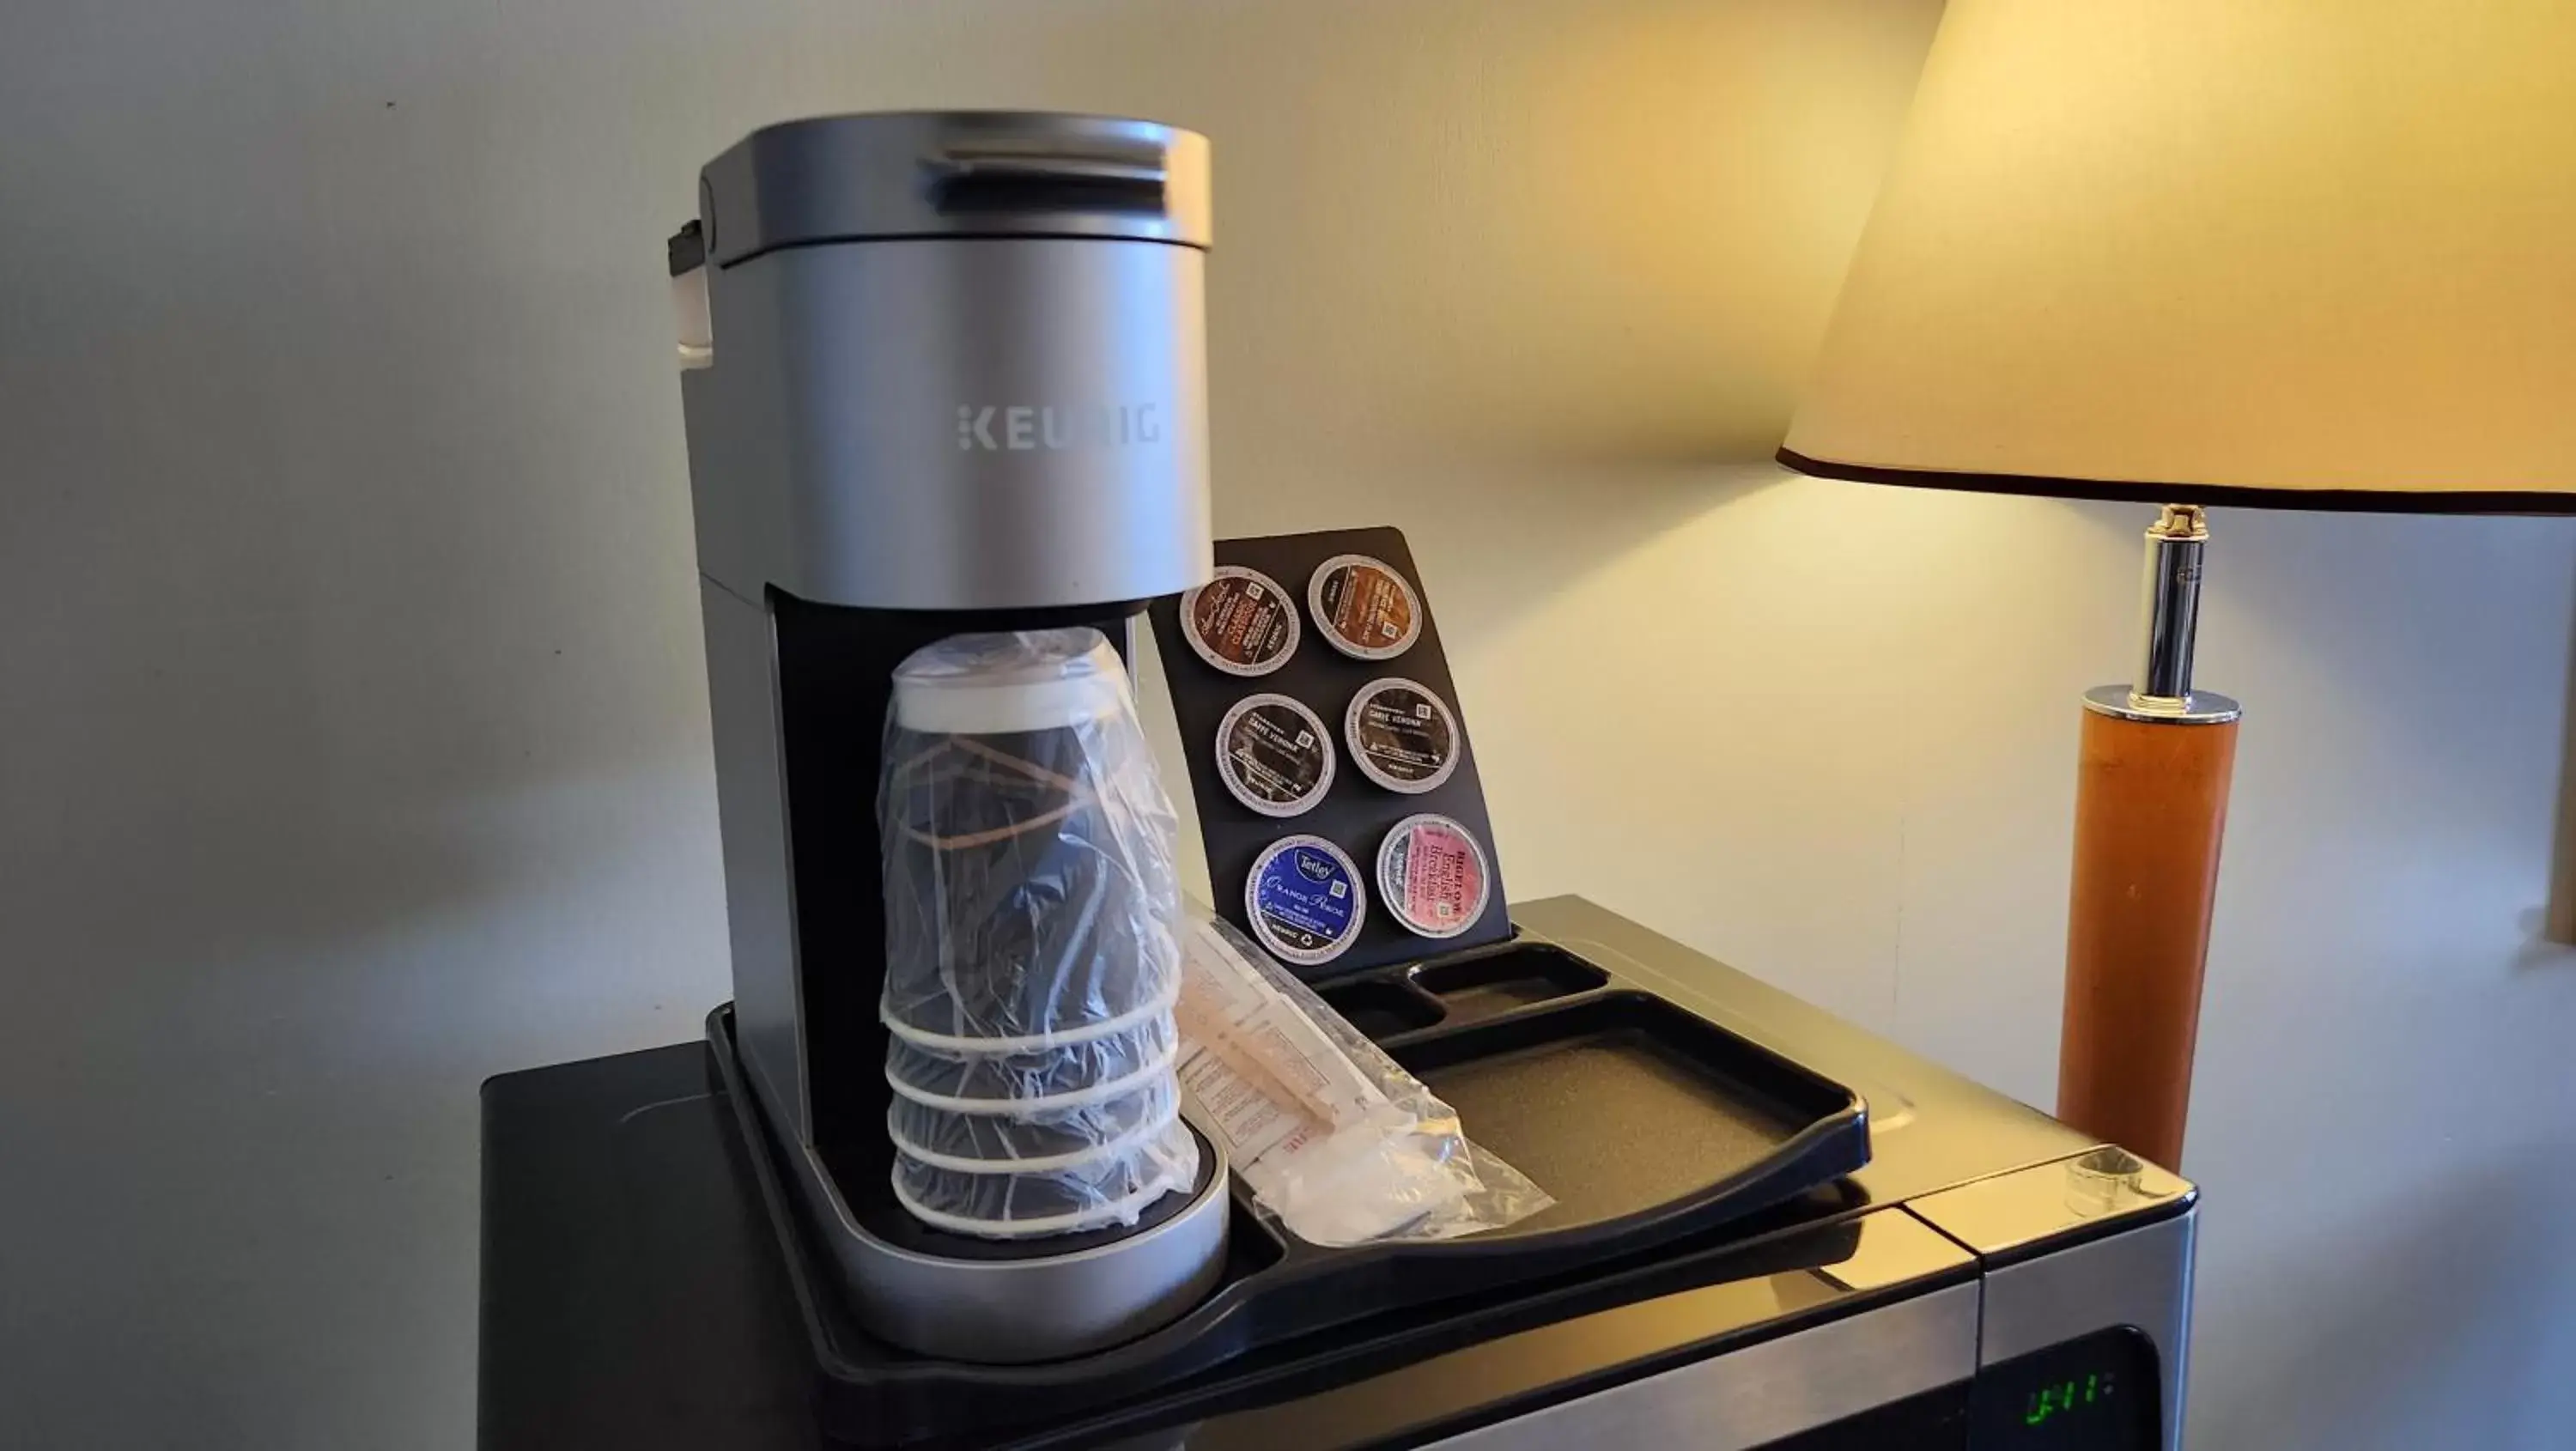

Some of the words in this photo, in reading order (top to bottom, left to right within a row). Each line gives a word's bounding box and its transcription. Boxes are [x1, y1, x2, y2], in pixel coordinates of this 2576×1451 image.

[957, 402, 1160, 450] KEUIG
[1301, 855, 1335, 879] Tetley
[1426, 845, 1443, 902] Breakfast
[1440, 853, 1455, 900] English
[1453, 851, 1466, 912] BIGELOW
